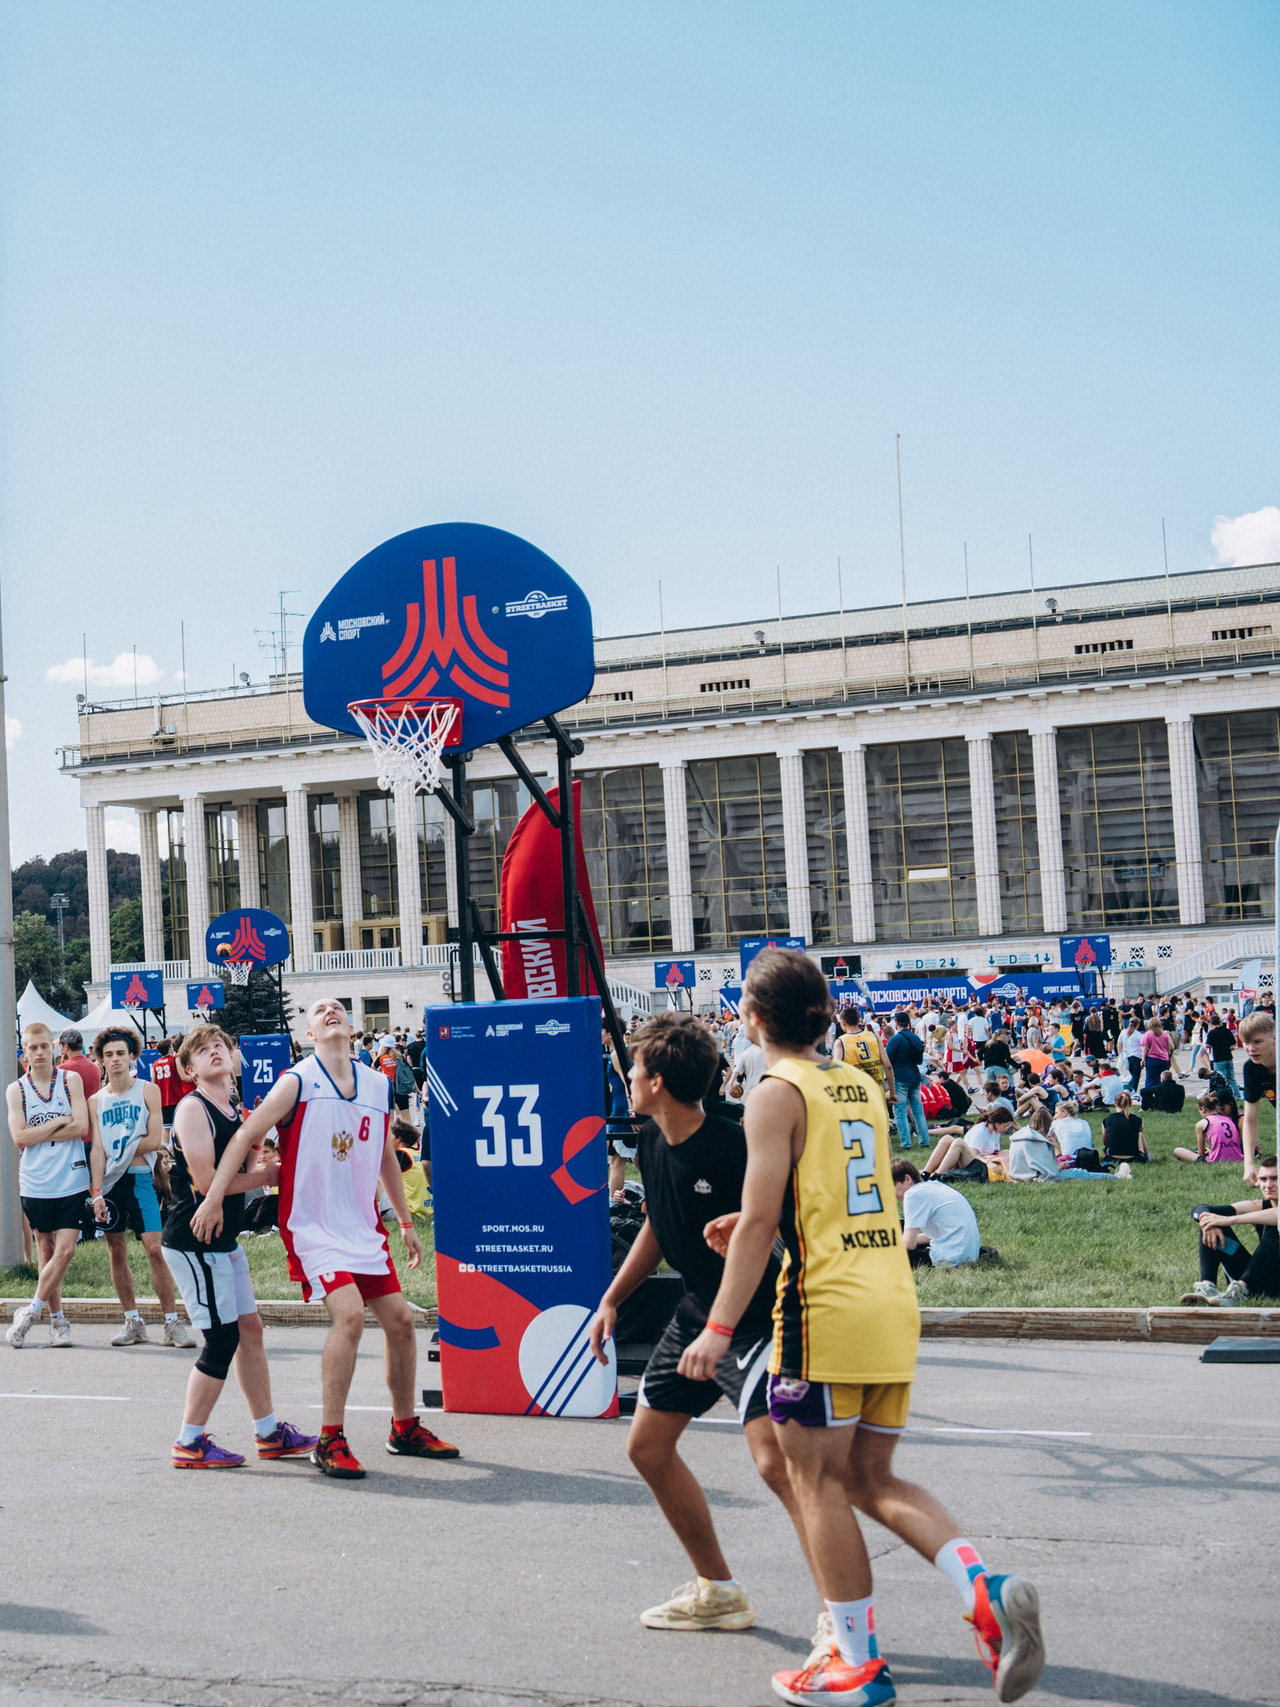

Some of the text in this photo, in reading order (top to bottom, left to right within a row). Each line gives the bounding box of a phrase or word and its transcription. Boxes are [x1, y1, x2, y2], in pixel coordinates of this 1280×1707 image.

[505, 599, 568, 613] STREETBASKET
[338, 612, 385, 630] МОСКОВСКИЙ
[338, 627, 361, 641] СПОРТ
[915, 959, 923, 969] D
[939, 958, 946, 967] 2
[1009, 954, 1017, 964] D
[1034, 953, 1039, 962] 1
[856, 1041, 871, 1060] 3
[155, 1065, 171, 1080] 33
[253, 1059, 273, 1083] 25
[102, 1104, 141, 1127] MAGIC
[358, 1116, 371, 1142] 6
[473, 1083, 544, 1167] 33
[1220, 1122, 1233, 1139] 3
[839, 1119, 884, 1216] 2
[482, 1224, 545, 1233] SPORT.MOS.RU
[475, 1244, 553, 1253] STREETBASKET.RU
[477, 1264, 572, 1273] STREETBASKETRUSSIA
